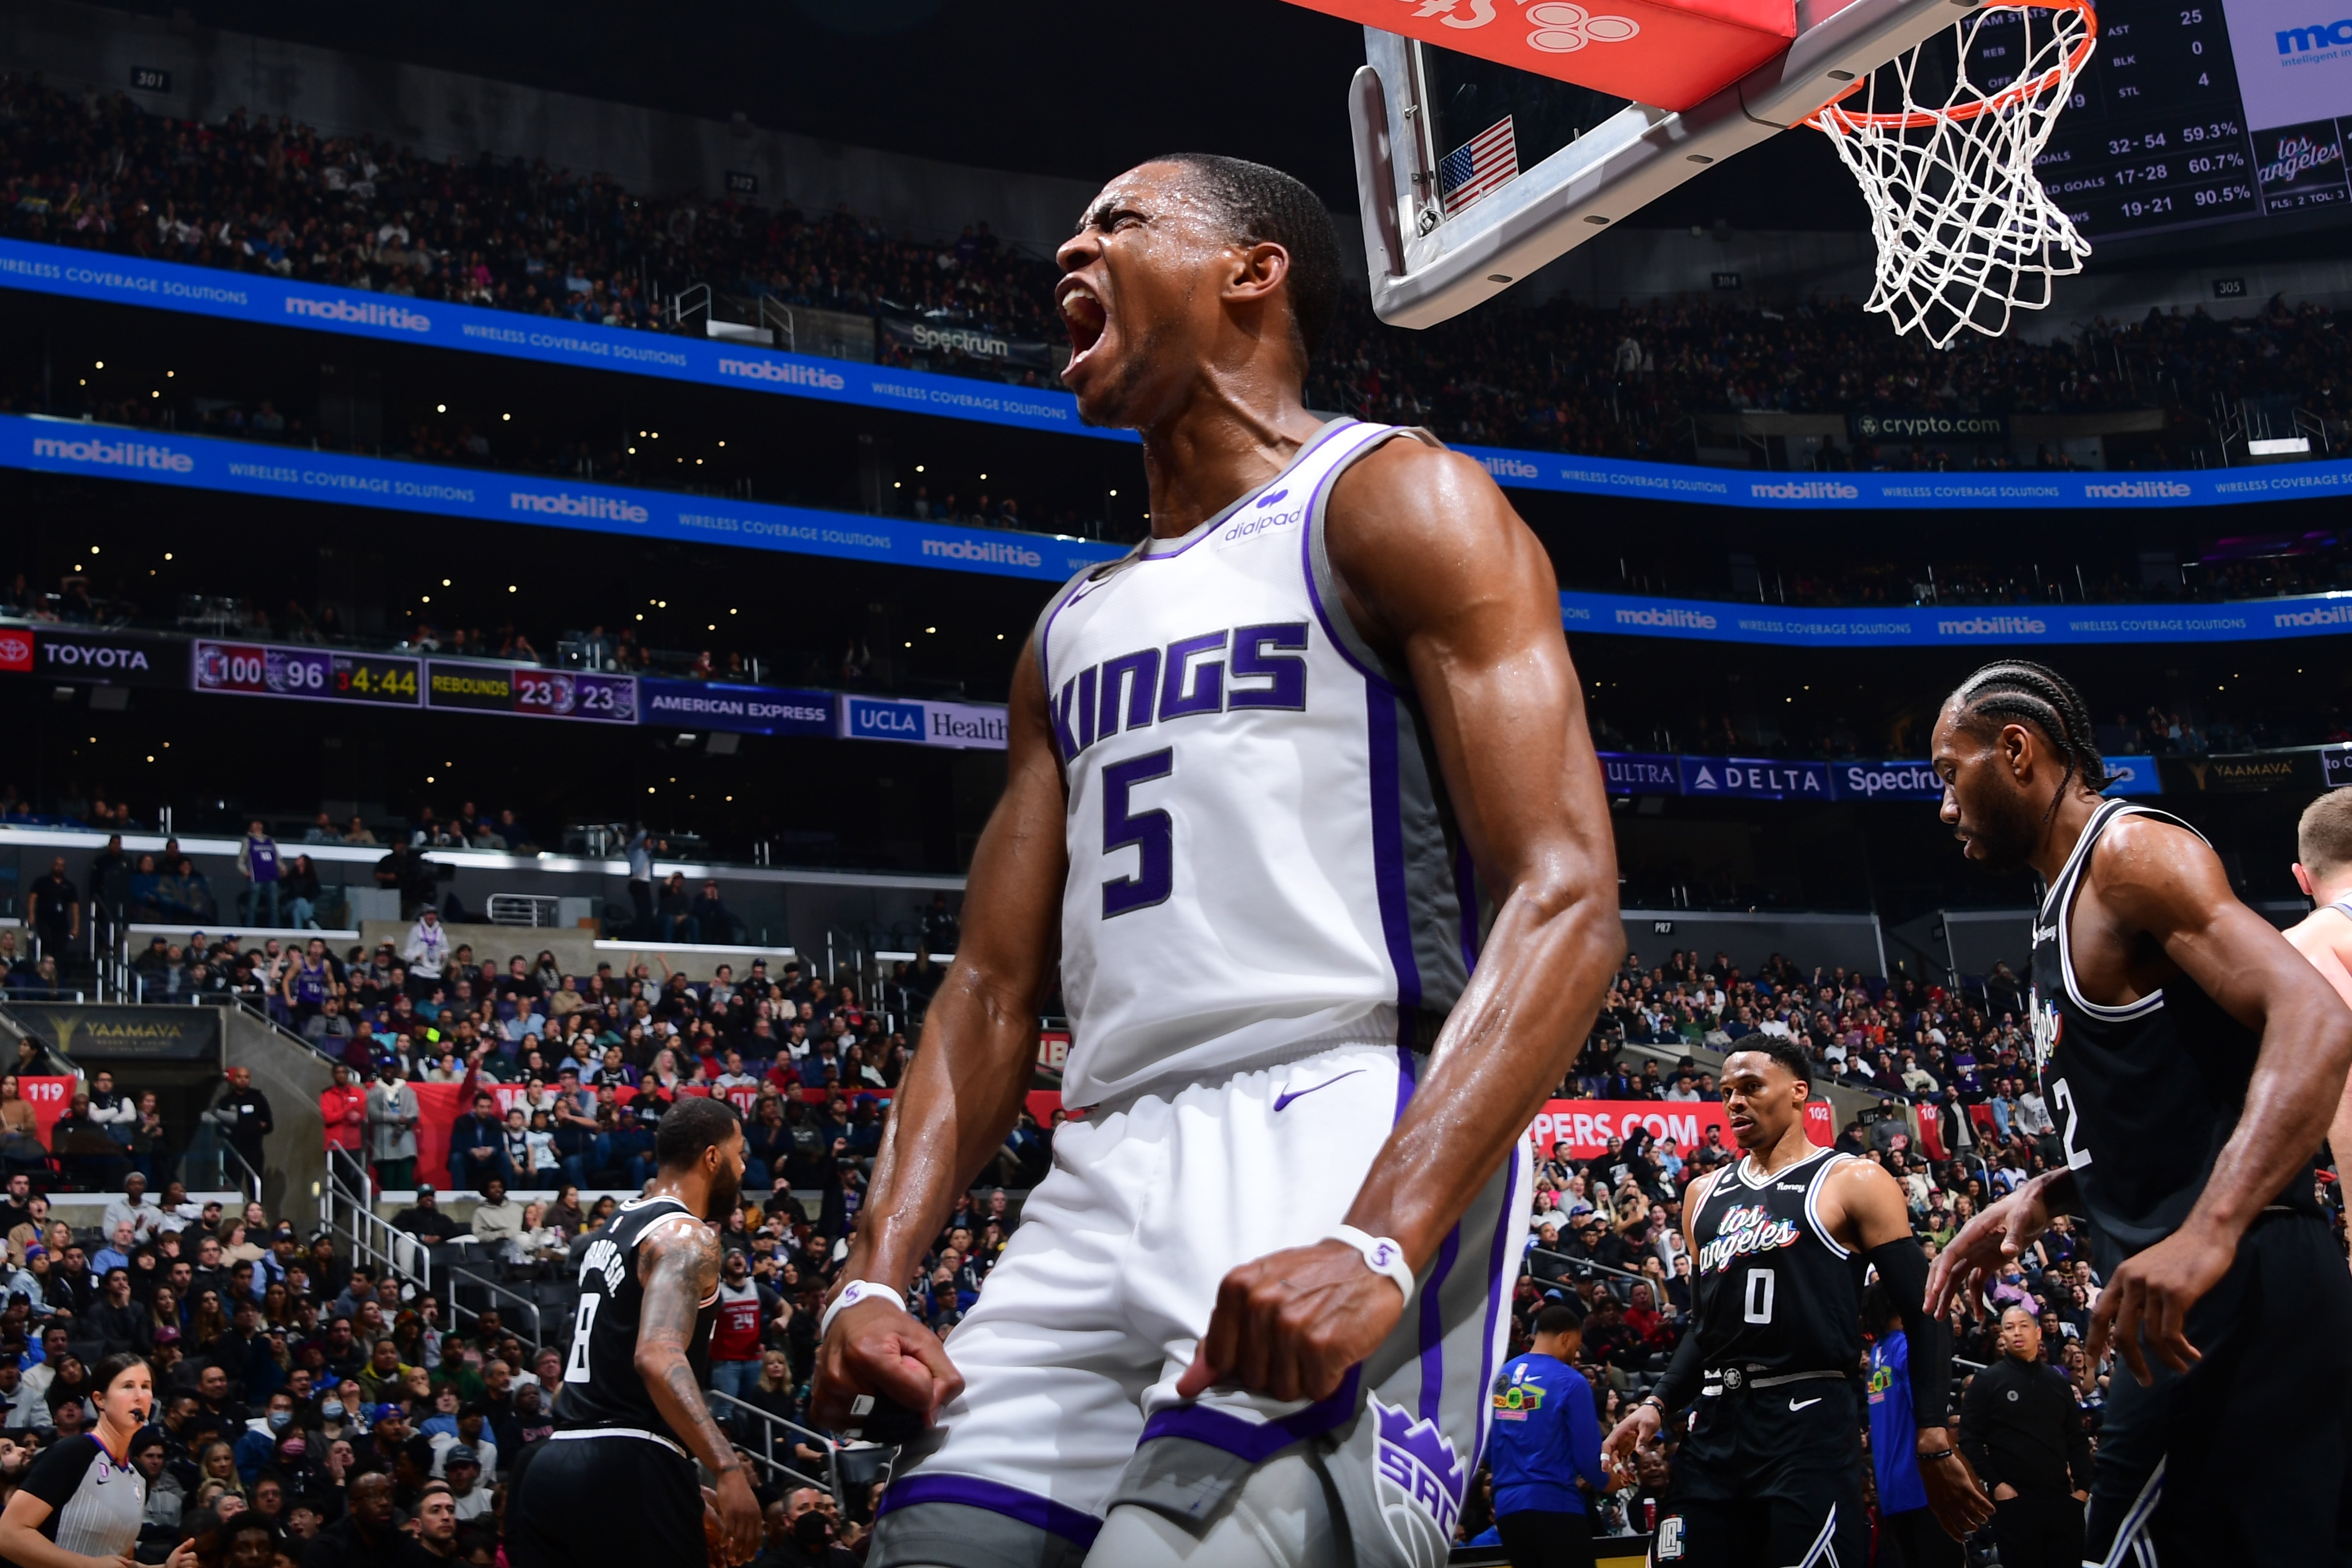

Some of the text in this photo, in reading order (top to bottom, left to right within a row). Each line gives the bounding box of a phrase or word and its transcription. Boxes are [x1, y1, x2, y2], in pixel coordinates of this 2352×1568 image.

[2108, 24, 2129, 37] AST
[2179, 9, 2202, 25] 25
[1982, 47, 2005, 58] REB
[2113, 54, 2136, 68] BLK
[2191, 41, 2203, 56] 0
[2282, 51, 2338, 68] intelligent
[137, 71, 163, 88] 301
[2119, 86, 2140, 98] STL
[2198, 72, 2210, 86] 4
[2182, 121, 2238, 143] 59.3%
[2064, 176, 2105, 192] GOALS
[2115, 164, 2168, 184] 17-28
[2188, 152, 2244, 173] 60.7%
[2121, 184, 2251, 217] 19-21 90.5%
[65, 267, 157, 292] COVERAGE
[163, 281, 248, 305] SOLUTIONS
[285, 297, 431, 332] mobilitie
[2219, 281, 2240, 294] 305
[913, 324, 1008, 356] Spectrum
[462, 324, 845, 390] WIRELESS COVERAGE SOLUTIONS mobilitie
[872, 383, 1067, 420] WIRELESS COVERAGE SOLUTIONS
[1882, 416, 2001, 435] crypto.com
[33, 438, 648, 523] mobilitie WIRELESS COVERAGE SOLUTIONS mobilitie
[1474, 457, 1858, 499] ilitie WIRELESS COVERAGE SOLUTIONS mobilitie
[1882, 481, 2191, 498] WIRELESS COVERAGE SOLUTIONS mobilitie
[2215, 480, 2268, 493] WIRELESS
[2271, 474, 2339, 489] COVERAGE
[1225, 506, 1301, 542] dialpad
[679, 514, 1042, 568] WIRELESS COVERAGE SOLUTIONS mobilitie
[1615, 608, 1717, 629] mobilitie
[1739, 620, 1784, 632] WIRELESS
[1786, 623, 1847, 635] COVERAGE
[1850, 623, 1911, 634] SOLUTIONS
[1938, 616, 2046, 635] mobilitie
[2069, 620, 2119, 631] WIRELESS
[2121, 620, 2183, 631] COVERAGE
[2185, 618, 2247, 630] SOLUTIONS
[43, 643, 149, 671] TOYOTA
[217, 656, 262, 684] 100
[287, 660, 324, 689] 96
[351, 666, 417, 696] 4:44
[431, 675, 613, 710] REBOUNDS 23 23
[1050, 621, 1309, 766] KINGS
[651, 695, 826, 722] AMERICAN EXPRESS
[860, 708, 917, 732] UCLA
[1607, 762, 1674, 784] ULTRA
[1725, 767, 1820, 791] DELTA
[1102, 746, 1173, 921] 5
[1654, 921, 1672, 933] PR7
[27, 1082, 65, 1102] 119
[1808, 1107, 1830, 1122] 102
[2052, 1076, 2093, 1171] 2
[1776, 1181, 1805, 1193] honey
[1718, 1206, 1767, 1237] los
[1699, 1219, 1798, 1274] angeles
[1744, 1267, 1775, 1325] 0
[732, 1312, 755, 1330] 24
[563, 1292, 601, 1384] 8
[1380, 1442, 1458, 1546] SAC
